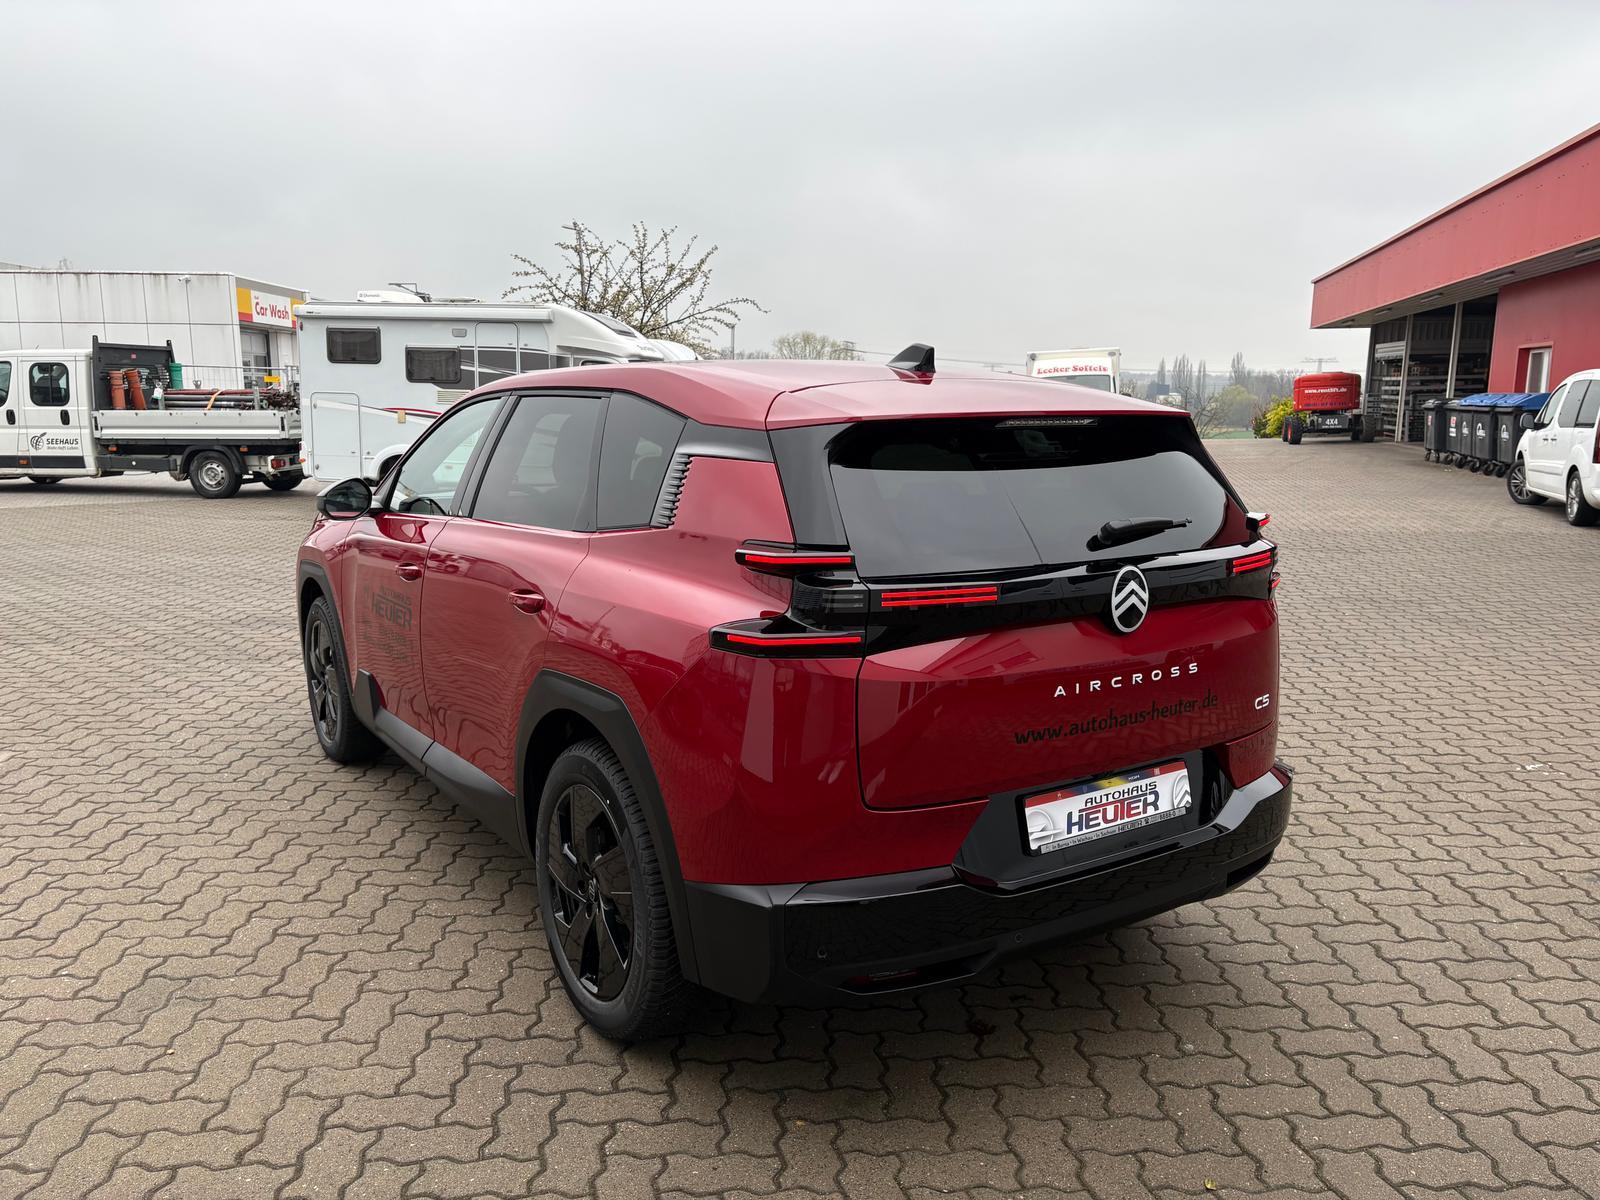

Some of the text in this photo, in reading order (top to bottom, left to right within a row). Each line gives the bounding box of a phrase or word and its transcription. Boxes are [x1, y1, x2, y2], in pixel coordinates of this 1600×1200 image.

[255, 301, 289, 320] Car Wash
[1054, 662, 1199, 698] AIRCROSS
[1014, 688, 1218, 745] www.autohaus-heuter.de
[1254, 693, 1270, 710] C5
[1084, 781, 1158, 807] AUTOHAUS
[1066, 789, 1160, 835] HEUTER
